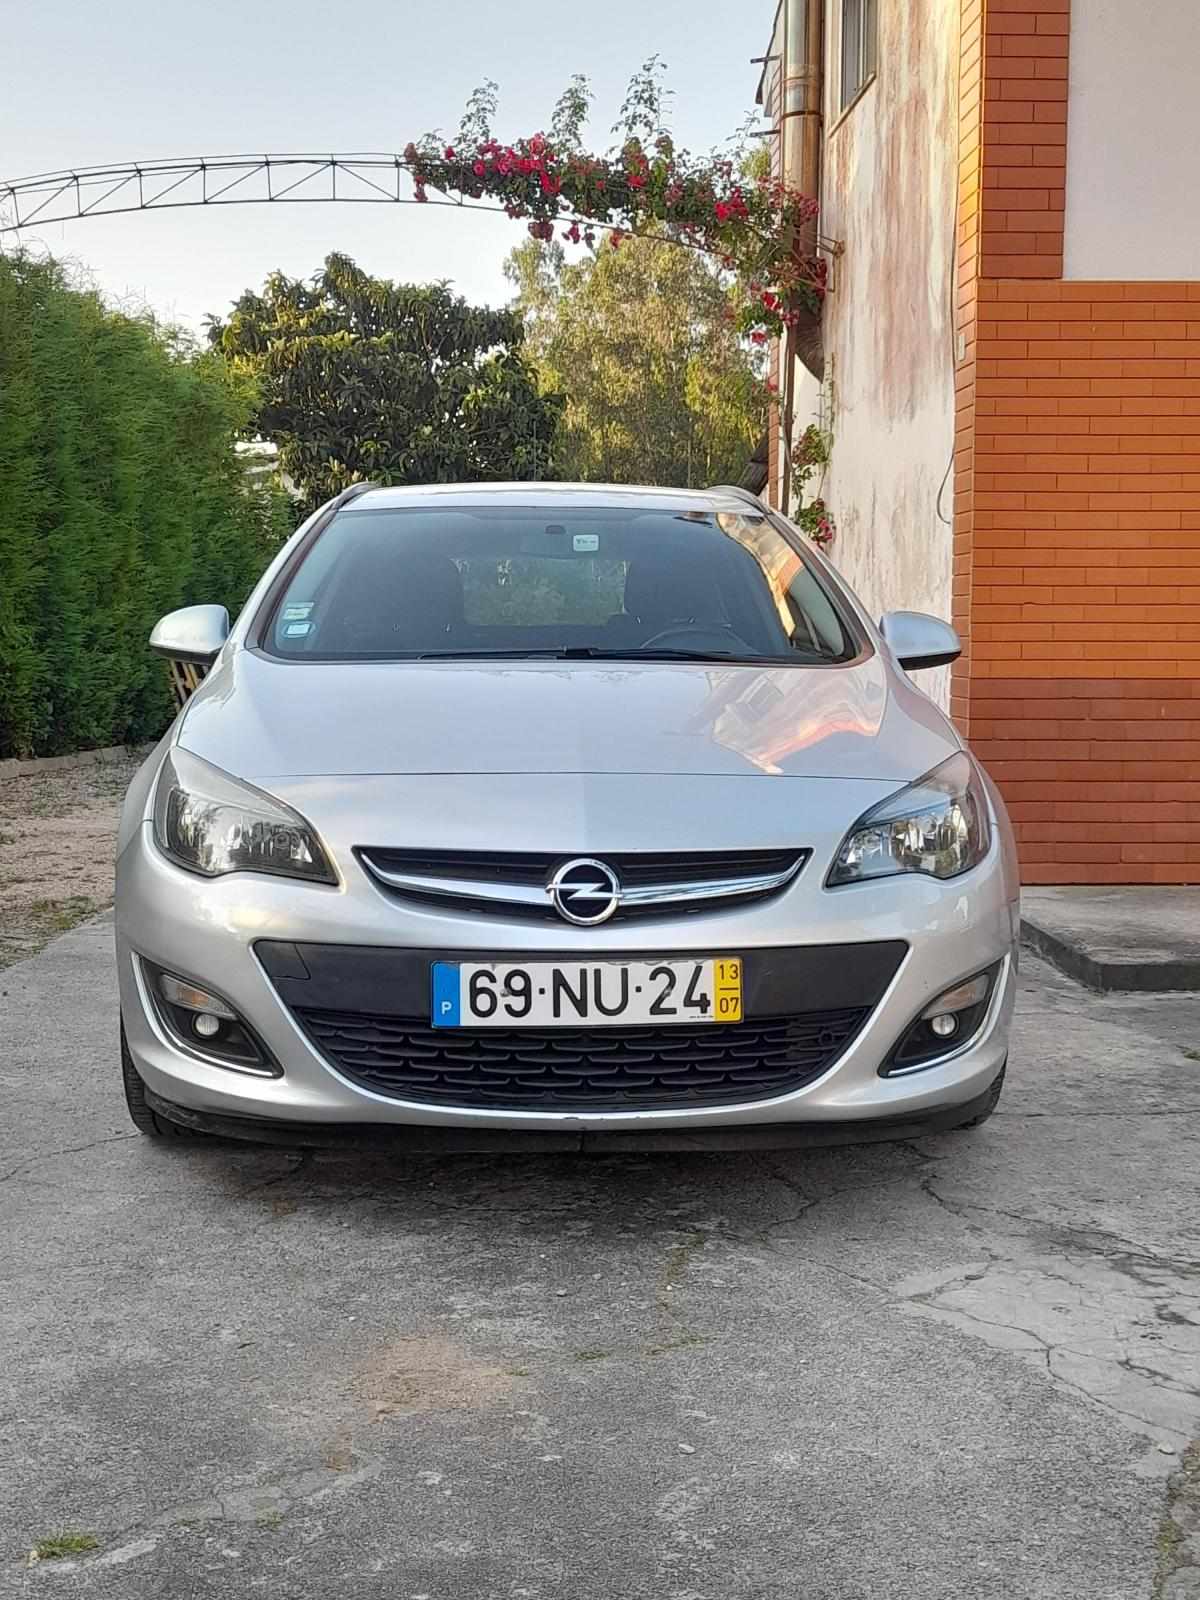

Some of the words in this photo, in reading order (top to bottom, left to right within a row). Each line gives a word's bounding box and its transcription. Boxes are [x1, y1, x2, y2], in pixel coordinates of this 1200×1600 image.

[719, 964, 738, 980] 13
[441, 1002, 452, 1015] P
[719, 997, 739, 1014] 07
